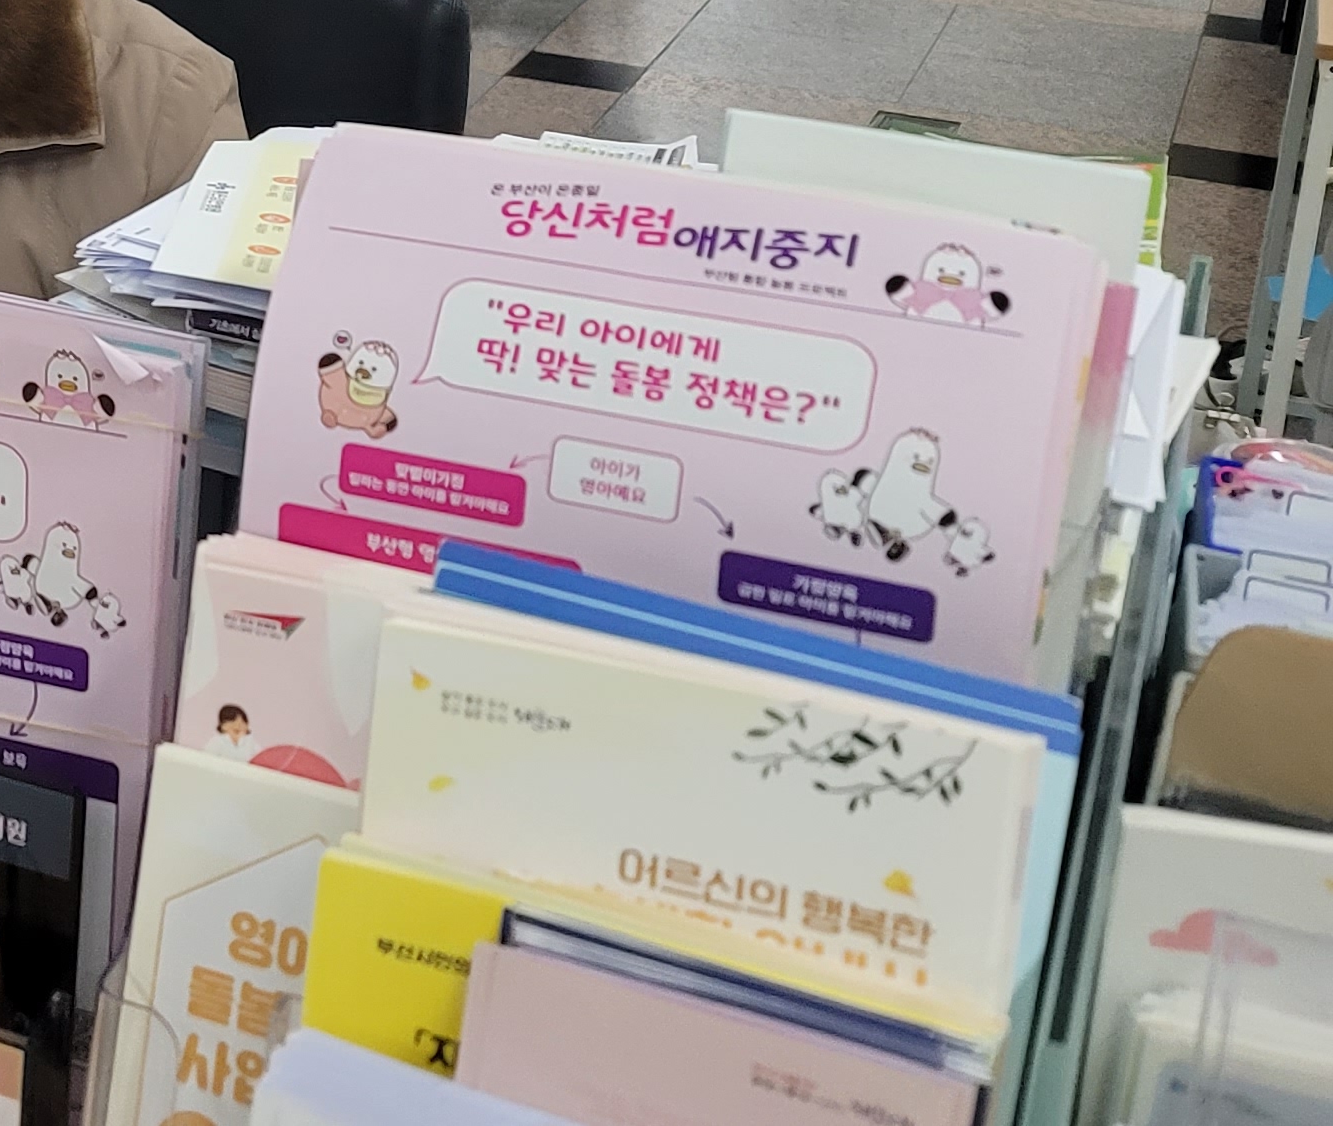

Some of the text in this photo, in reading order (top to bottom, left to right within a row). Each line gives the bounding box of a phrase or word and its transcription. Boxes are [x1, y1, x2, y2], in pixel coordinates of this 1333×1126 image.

[490, 184, 503, 196] 온
[510, 184, 552, 197] 부산이
[500, 199, 860, 270] 당신처럼 애지중지
[487, 299, 721, 363] "우리 아이에게
[476, 337, 841, 423] 딱! 맞는 돌봄 정책은?"
[590, 457, 641, 482] 아이가
[366, 532, 414, 559] 부산형
[617, 846, 932, 959] 어르신의 행복한
